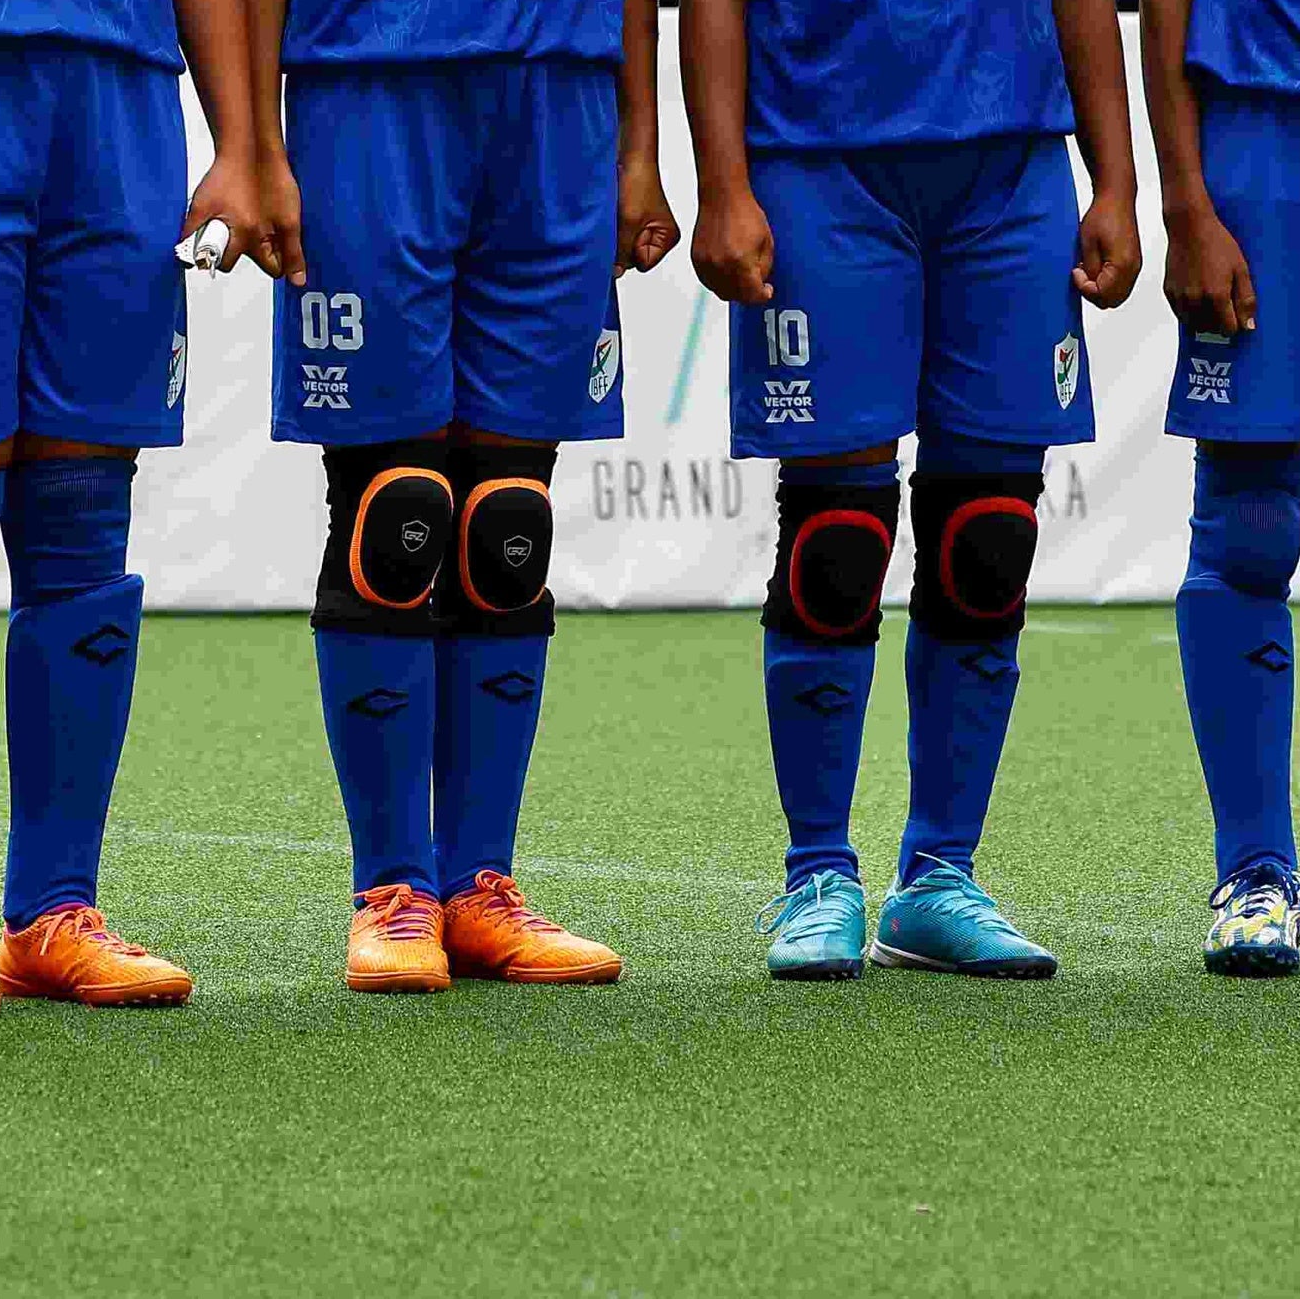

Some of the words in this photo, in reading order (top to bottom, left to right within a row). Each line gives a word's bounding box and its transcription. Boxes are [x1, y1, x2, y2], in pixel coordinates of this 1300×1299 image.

[301, 291, 364, 351] 03
[764, 309, 810, 366] 10
[302, 381, 349, 394] VECTOR
[591, 375, 609, 396] IBFF
[1188, 373, 1230, 388] VECTOR
[764, 396, 812, 408] VECTOR
[591, 460, 743, 523] GRAND
